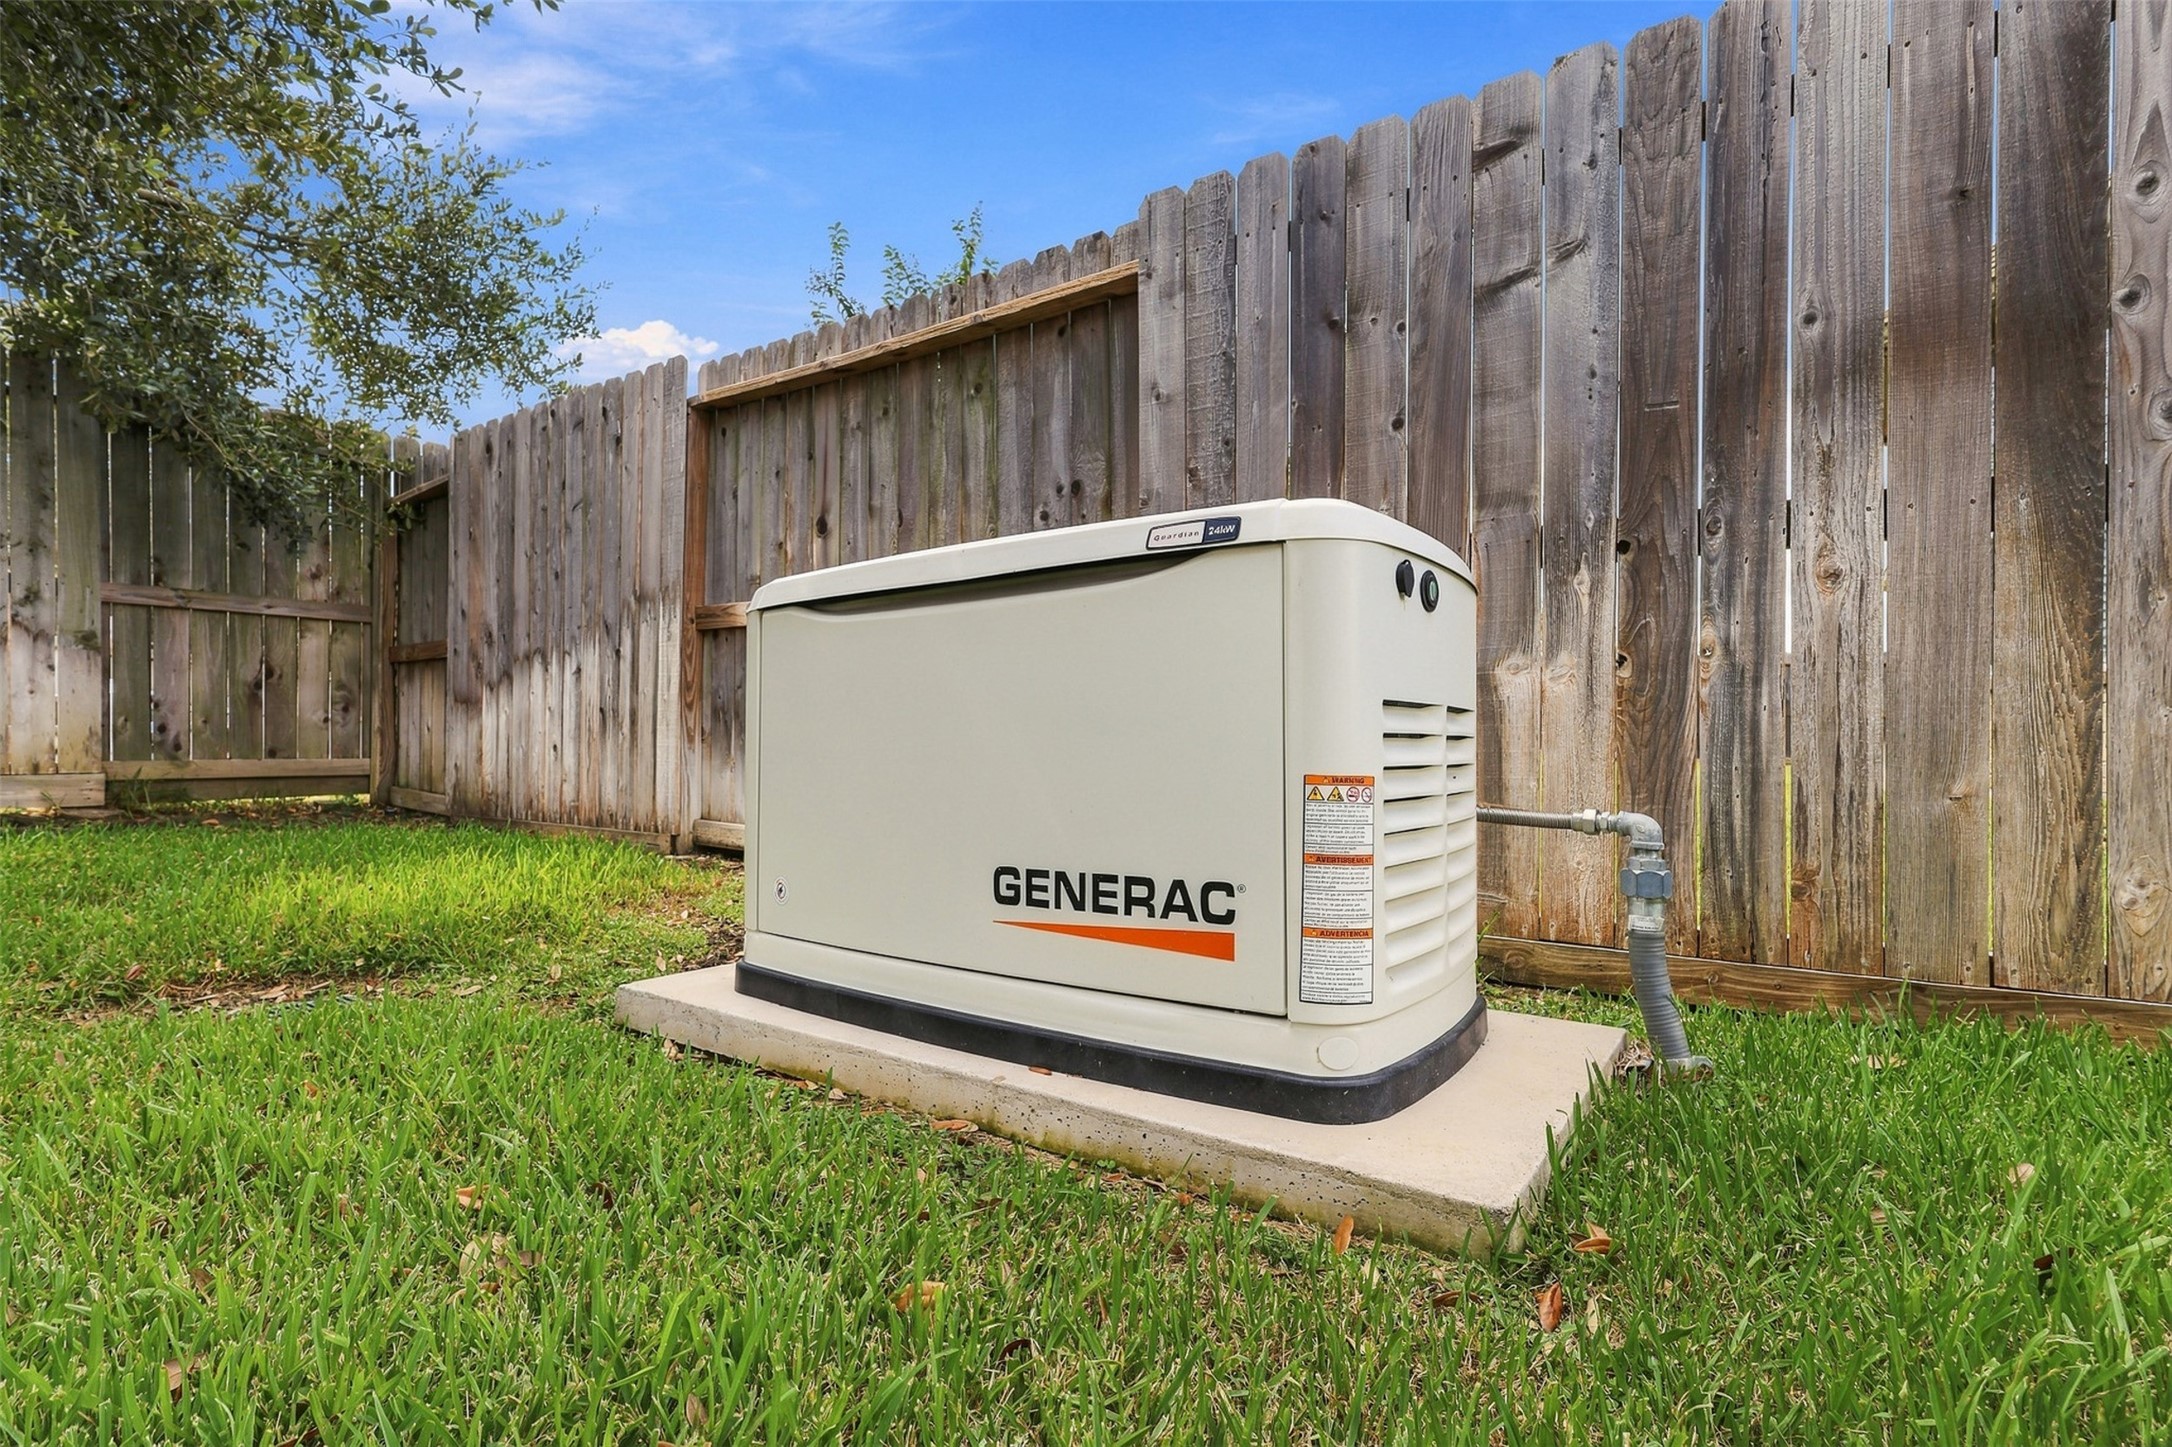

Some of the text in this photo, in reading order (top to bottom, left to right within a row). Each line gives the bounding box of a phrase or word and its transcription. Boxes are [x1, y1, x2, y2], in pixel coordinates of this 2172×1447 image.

[1153, 525, 1236, 542] Guardian 24kW
[1315, 856, 1372, 864] AVERTISSEMENT
[993, 866, 1236, 926] GENERAC
[1319, 930, 1369, 938] ADVERTENCIA
